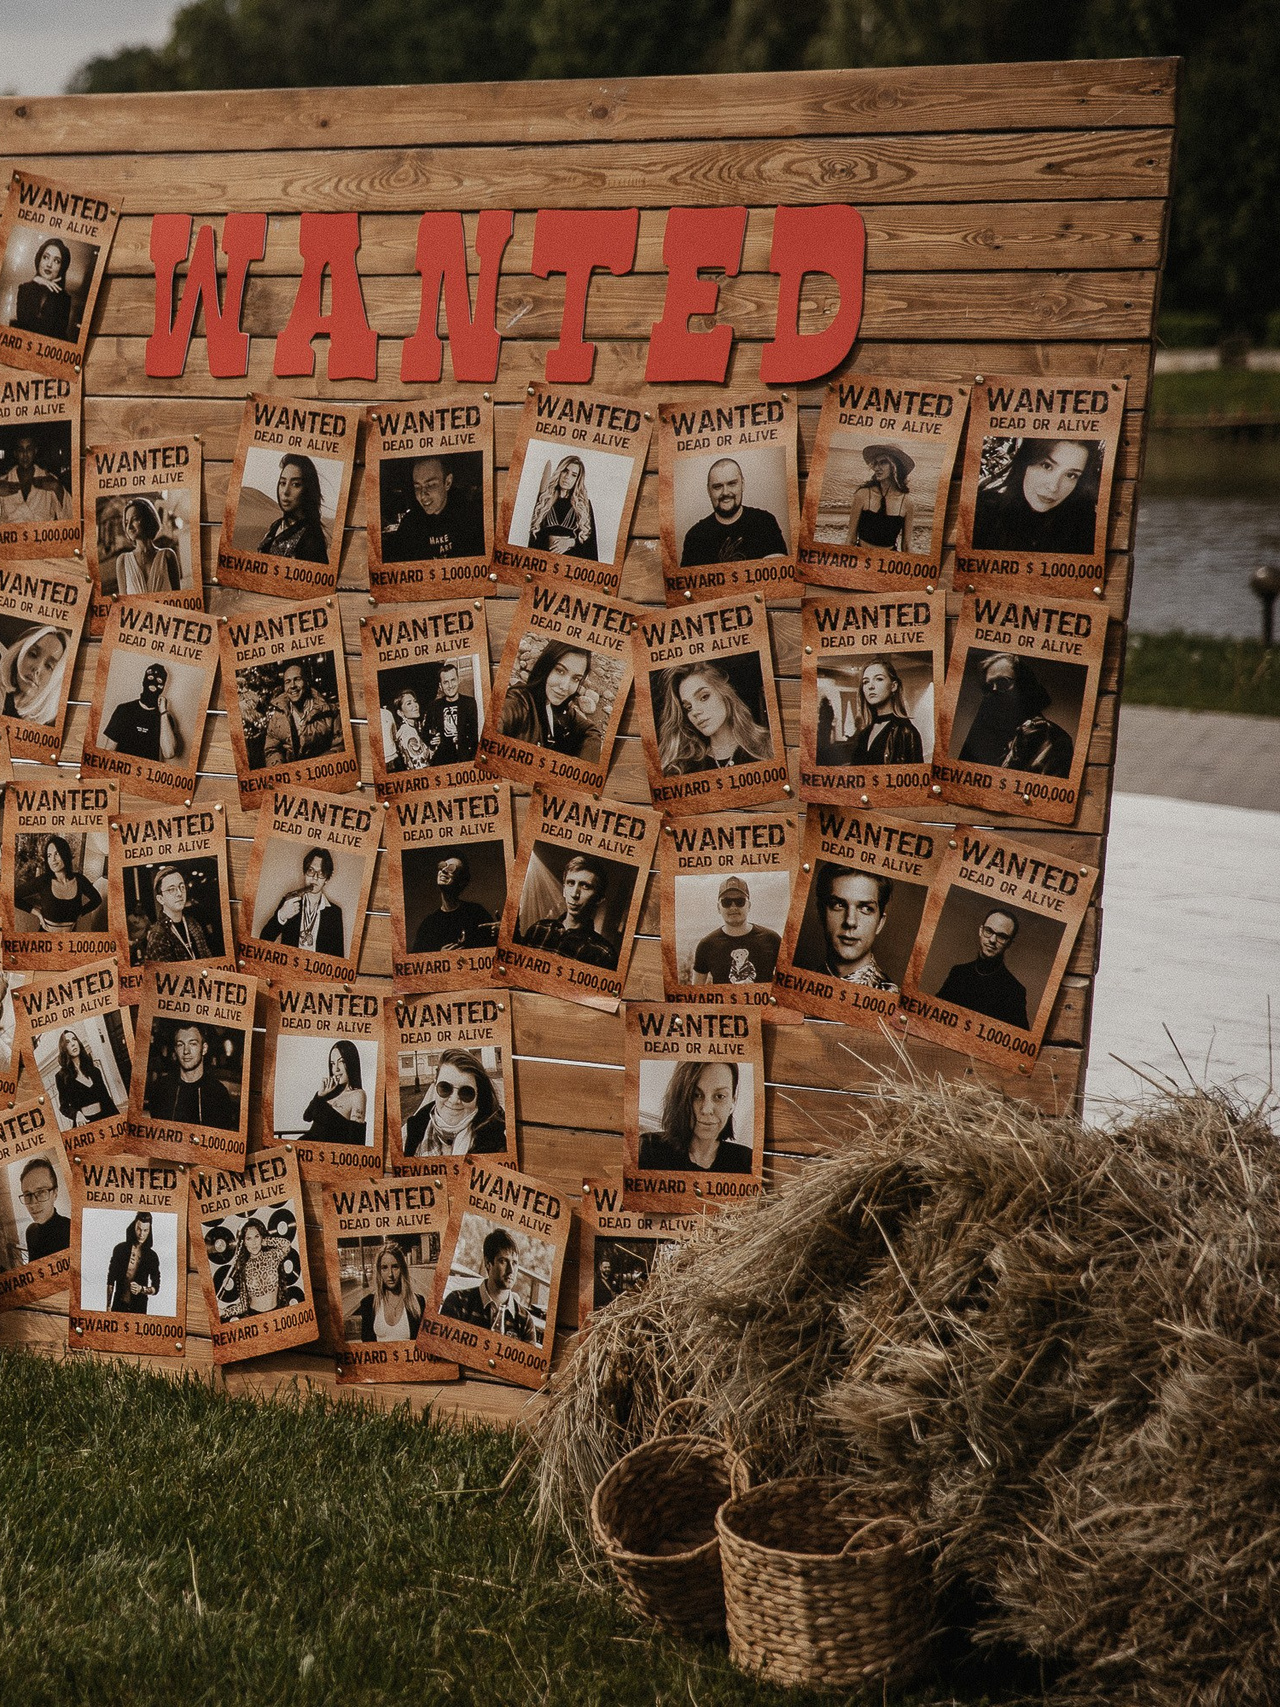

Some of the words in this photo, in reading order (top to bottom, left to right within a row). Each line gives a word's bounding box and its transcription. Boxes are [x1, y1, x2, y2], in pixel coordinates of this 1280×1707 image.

[19, 181, 108, 222] WANTED
[17, 208, 45, 223] DEAD
[49, 216, 62, 228] OR
[66, 221, 98, 237] ALIVE
[145, 204, 868, 384] WANTED
[26, 340, 33, 352] $
[36, 342, 81, 366] 1,000,000
[535, 392, 640, 432] WANTED
[838, 383, 952, 417] WANTED
[986, 386, 1108, 414] WANTED
[254, 402, 347, 437] WANTED
[376, 405, 480, 436] WANTED
[670, 400, 783, 436] WANTED
[838, 413, 873, 427] DEAD
[879, 417, 896, 430] OR
[901, 420, 943, 435] ALIVE
[989, 416, 1025, 429] DEAD
[1032, 418, 1050, 430] OR
[1056, 419, 1099, 431] ALIVE
[254, 430, 283, 444] DEAD
[288, 435, 301, 447] OR
[306, 438, 339, 453] ALIVE
[382, 438, 413, 451] DEAD
[419, 436, 433, 448] OR
[439, 432, 475, 446] ALIVE
[676, 437, 710, 451] DEAD
[716, 434, 732, 447] OR
[739, 428, 778, 444] ALIVE
[93, 445, 189, 474] WANTED
[98, 477, 127, 489] DEAD
[132, 475, 145, 486] OR
[151, 471, 184, 484] ALIVE
[22, 529, 28, 542] $
[33, 527, 80, 544] 1,000,000
[217, 554, 268, 574] REWARD
[273, 563, 279, 577] $
[284, 566, 334, 587] 1,000,000
[492, 549, 547, 572] REWARD
[552, 561, 559, 575] $
[564, 564, 617, 587] 1,000,000
[797, 547, 858, 568] REWARD
[864, 556, 871, 570] $
[877, 558, 936, 579] 1,000,000
[956, 558, 1019, 574] REWARD
[1026, 561, 1033, 575] $
[1040, 562, 1102, 581] 1,000,000
[20, 601, 33, 613] OR
[37, 605, 69, 621] ALIVE
[119, 605, 212, 645] WANTED
[532, 585, 631, 637] WANTED
[640, 604, 753, 647] WANTED
[815, 602, 930, 632] WANTED
[974, 597, 1092, 638] WANTED
[227, 607, 328, 647] WANTED
[370, 610, 473, 647] WANTED
[820, 635, 854, 647] DEAD
[861, 634, 877, 646] OR
[884, 631, 925, 645] ALIVE
[975, 627, 1011, 643] DEAD
[1017, 634, 1034, 648] OR
[1040, 638, 1083, 655] ALIVE
[118, 632, 146, 647] DEAD
[150, 640, 165, 652] OR
[168, 644, 202, 660] ALIVE
[236, 646, 266, 661] DEAD
[271, 642, 285, 654] OR
[291, 634, 325, 650] ALIVE
[650, 646, 683, 662] DEAD
[689, 642, 704, 655] OR
[711, 633, 750, 651] ALIVE
[83, 752, 131, 775] REWARD
[135, 765, 142, 778] $
[145, 767, 193, 791] 1,000,000
[480, 737, 533, 765] REWARD
[538, 756, 545, 769] $
[549, 760, 603, 788] 1,000,000
[651, 780, 710, 803] REWARD
[715, 776, 723, 791] $
[728, 766, 787, 790] 1,000,000
[14, 788, 108, 811] WANTED
[272, 792, 371, 832] WANTED
[395, 794, 499, 826] WANTED
[18, 815, 46, 826] DEAD
[51, 815, 64, 825] OR
[70, 814, 103, 825] ALIVE
[118, 812, 214, 845] WANTED
[402, 828, 433, 841] DEAD
[439, 826, 453, 838] OR
[459, 821, 495, 836] ALIVE
[542, 793, 645, 840] WANTED
[273, 819, 302, 834] DEAD
[307, 827, 321, 839] OR
[326, 831, 362, 848] ALIVE
[671, 823, 785, 852] WANTED
[819, 810, 932, 859] WANTED
[124, 846, 153, 859] DEAD
[158, 843, 172, 855] OR
[177, 838, 210, 852] ALIVE
[962, 836, 1079, 896] WANTED
[959, 866, 994, 887] DEAD
[999, 881, 1017, 896] OR
[1021, 889, 1065, 912] ALIVE
[3, 939, 52, 954] REWARD
[57, 939, 63, 952] $
[68, 940, 116, 955] 1,000,000
[238, 943, 287, 965] REWARD
[292, 955, 299, 969] $
[303, 958, 354, 982] 1,000,000
[21, 968, 113, 1015] WANTED
[154, 971, 248, 1007] WANTED
[277, 989, 377, 1017] WANTED
[281, 1017, 311, 1029] DEAD
[316, 1019, 331, 1031] OR
[336, 1021, 371, 1033] ALIVE
[393, 1000, 497, 1028] WANTED
[639, 1012, 751, 1038] WANTED
[898, 994, 958, 1027] REWARD
[963, 1018, 971, 1033] $
[975, 1023, 1037, 1057] 1,000,000
[400, 1032, 431, 1044] DEAD
[437, 1030, 451, 1042] OR
[457, 1027, 493, 1040] ALIVE
[82, 1164, 177, 1190] WANTED
[86, 1190, 114, 1202] DEAD
[119, 1193, 133, 1204] OR
[138, 1194, 171, 1206] ALIVE
[332, 1185, 435, 1214] WANTED
[469, 1166, 560, 1219] WANTED
[339, 1217, 370, 1229] DEAD
[375, 1216, 390, 1227] OR
[396, 1213, 431, 1226] ALIVE
[69, 1316, 118, 1332] REWARD
[123, 1320, 129, 1334] $
[134, 1322, 183, 1339] 1,000,000
[211, 1324, 258, 1349] REWARD
[262, 1320, 268, 1334] $
[272, 1308, 316, 1333] 1,000,000
